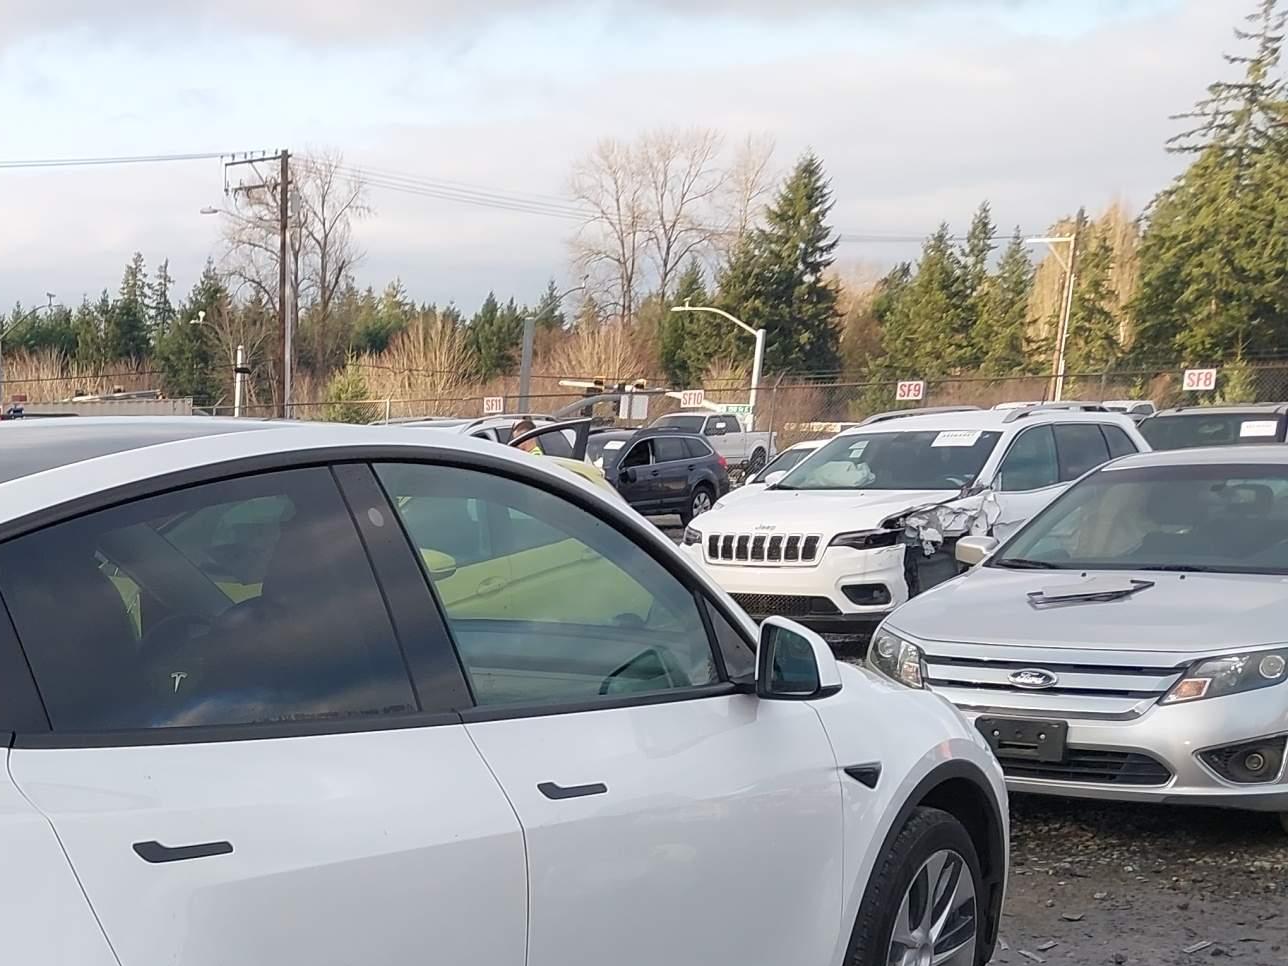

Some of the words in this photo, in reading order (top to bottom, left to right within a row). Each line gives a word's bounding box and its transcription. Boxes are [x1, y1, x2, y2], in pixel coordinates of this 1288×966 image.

[1186, 371, 1213, 388] SF8
[898, 383, 921, 398] SF9
[485, 399, 501, 411] SF11
[682, 392, 703, 406] SF10
[1015, 671, 1046, 684] Ford
